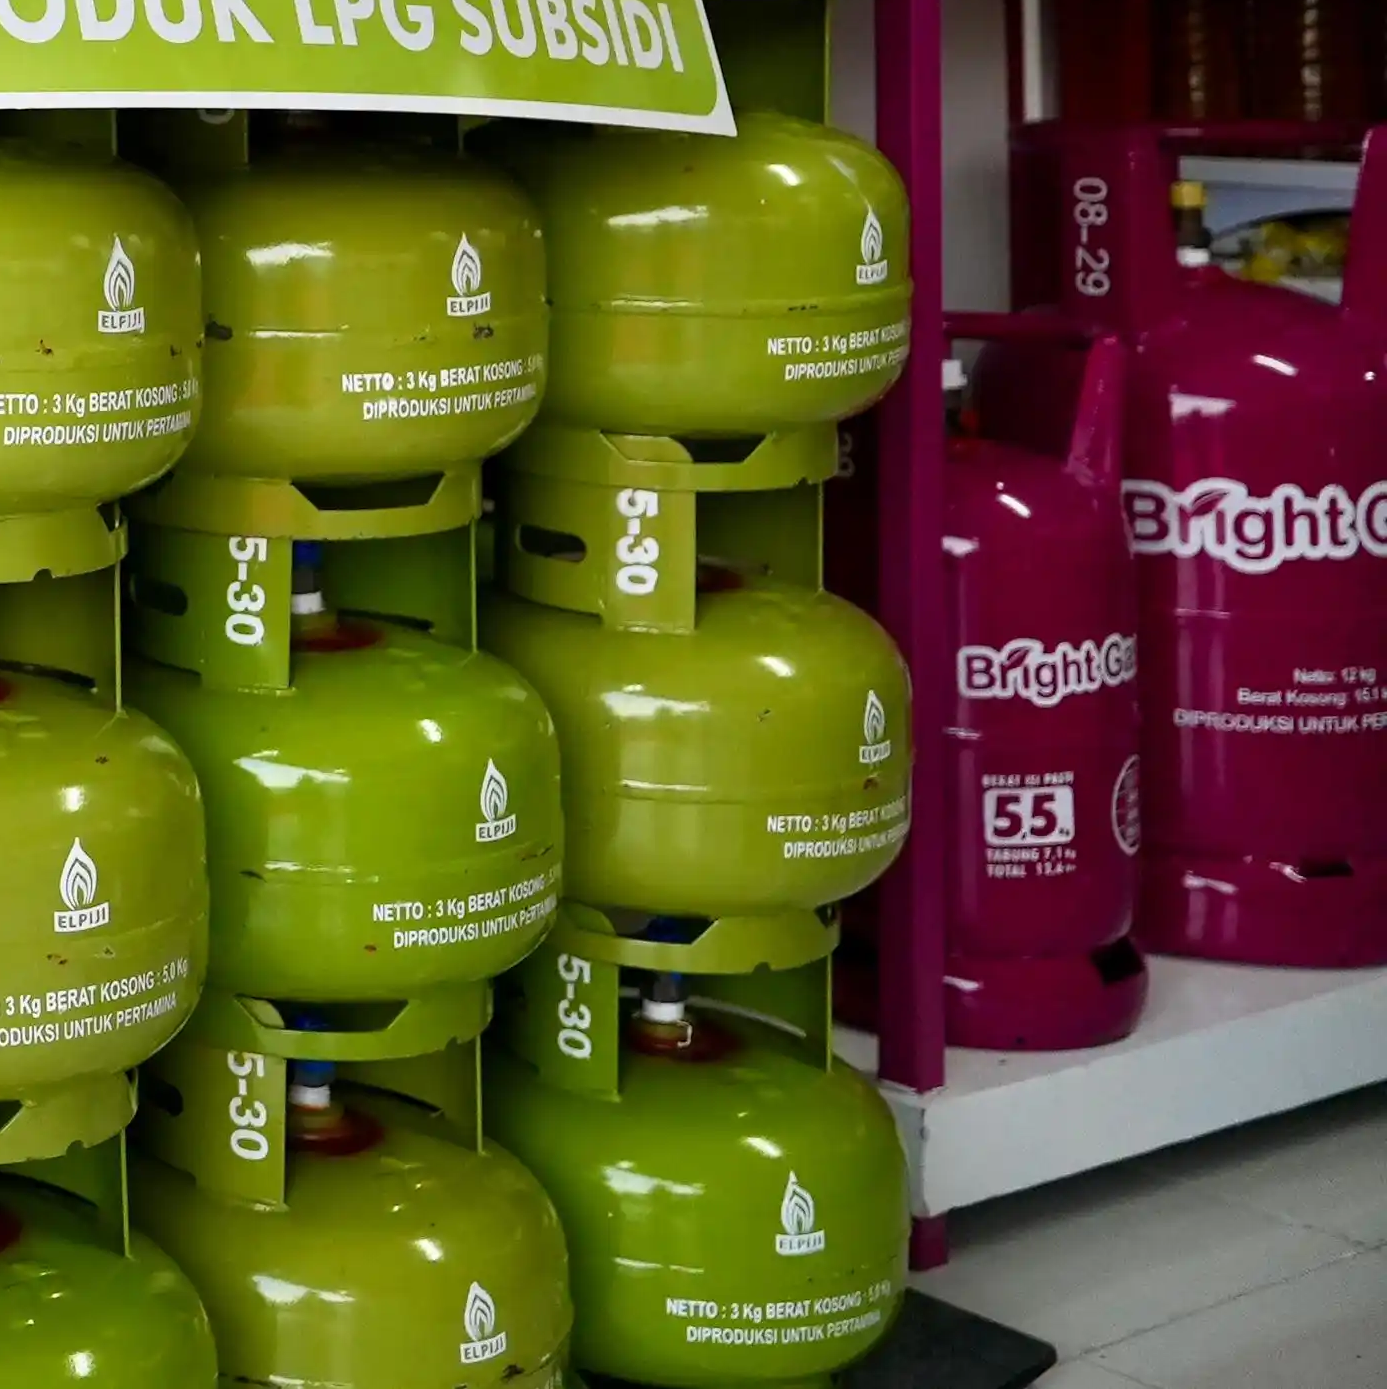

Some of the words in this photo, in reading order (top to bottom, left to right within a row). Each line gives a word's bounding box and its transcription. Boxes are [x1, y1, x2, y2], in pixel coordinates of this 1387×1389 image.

[1073, 176, 1111, 297] 08-29
[89, 390, 133, 412] BERAT
[135, 383, 177, 408] KOSONG
[615, 488, 660, 596] 5-30
[1120, 478, 1359, 574] Bright
[224, 536, 268, 648] 5-30
[957, 639, 1097, 707] Bright
[57, 907, 106, 929] ELPIJI
[6, 995, 15, 1015] 3
[20, 994, 41, 1018] Kg
[46, 986, 96, 1014] BERAT
[100, 971, 155, 1001] KOSONG
[162, 962, 175, 983] 5,0
[177, 957, 188, 978] Kg
[64, 1014, 112, 1040] UNTUK
[116, 992, 176, 1028] PERTAMINA
[666, 1298, 718, 1319] NETTO
